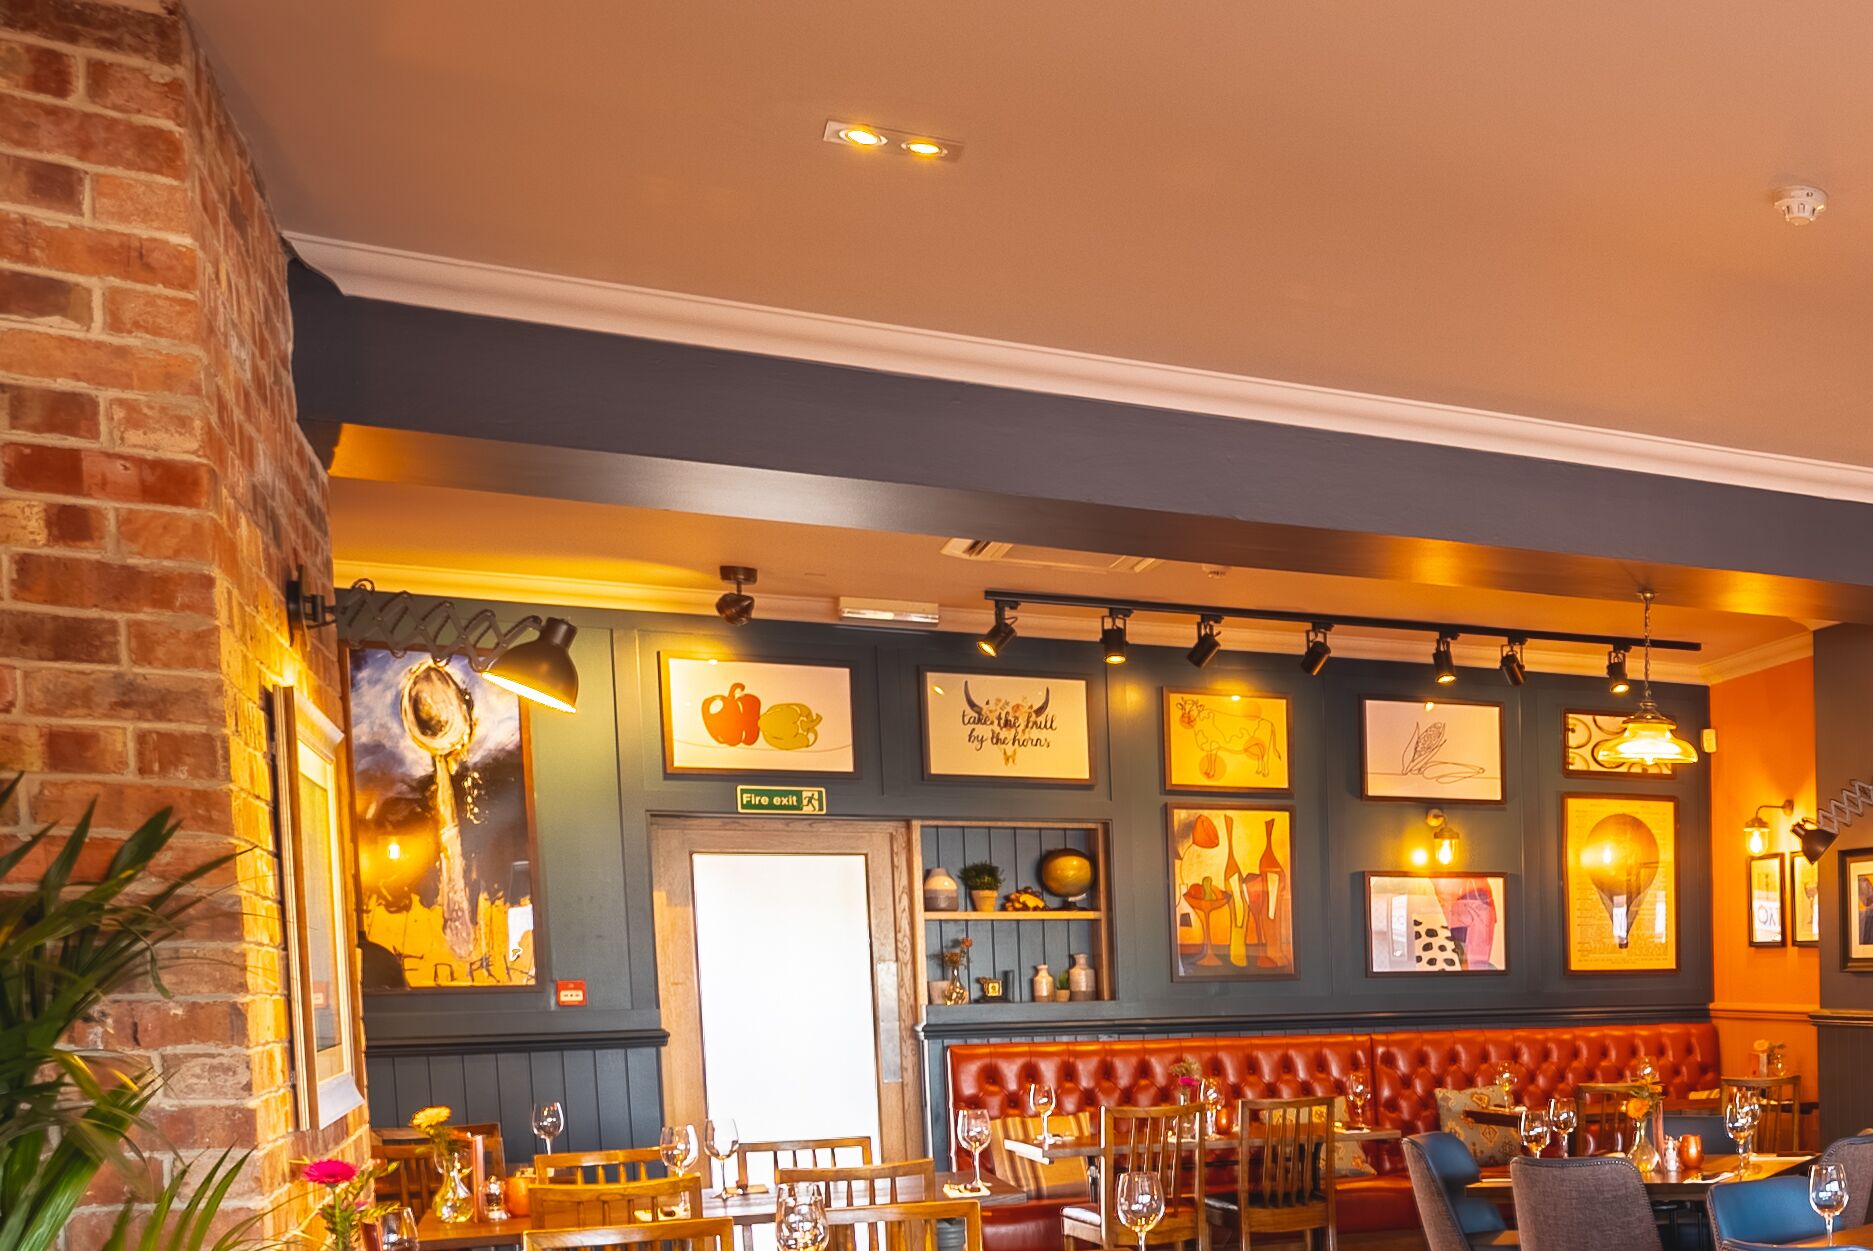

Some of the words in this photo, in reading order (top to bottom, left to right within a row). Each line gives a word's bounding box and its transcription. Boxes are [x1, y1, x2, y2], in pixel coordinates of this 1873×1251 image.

[961, 710, 994, 726] take
[996, 711, 1020, 730] the
[968, 728, 987, 752] by
[991, 729, 1009, 746] the
[1011, 730, 1050, 748] horns
[742, 793, 769, 806] Fire
[772, 794, 798, 806] exit
